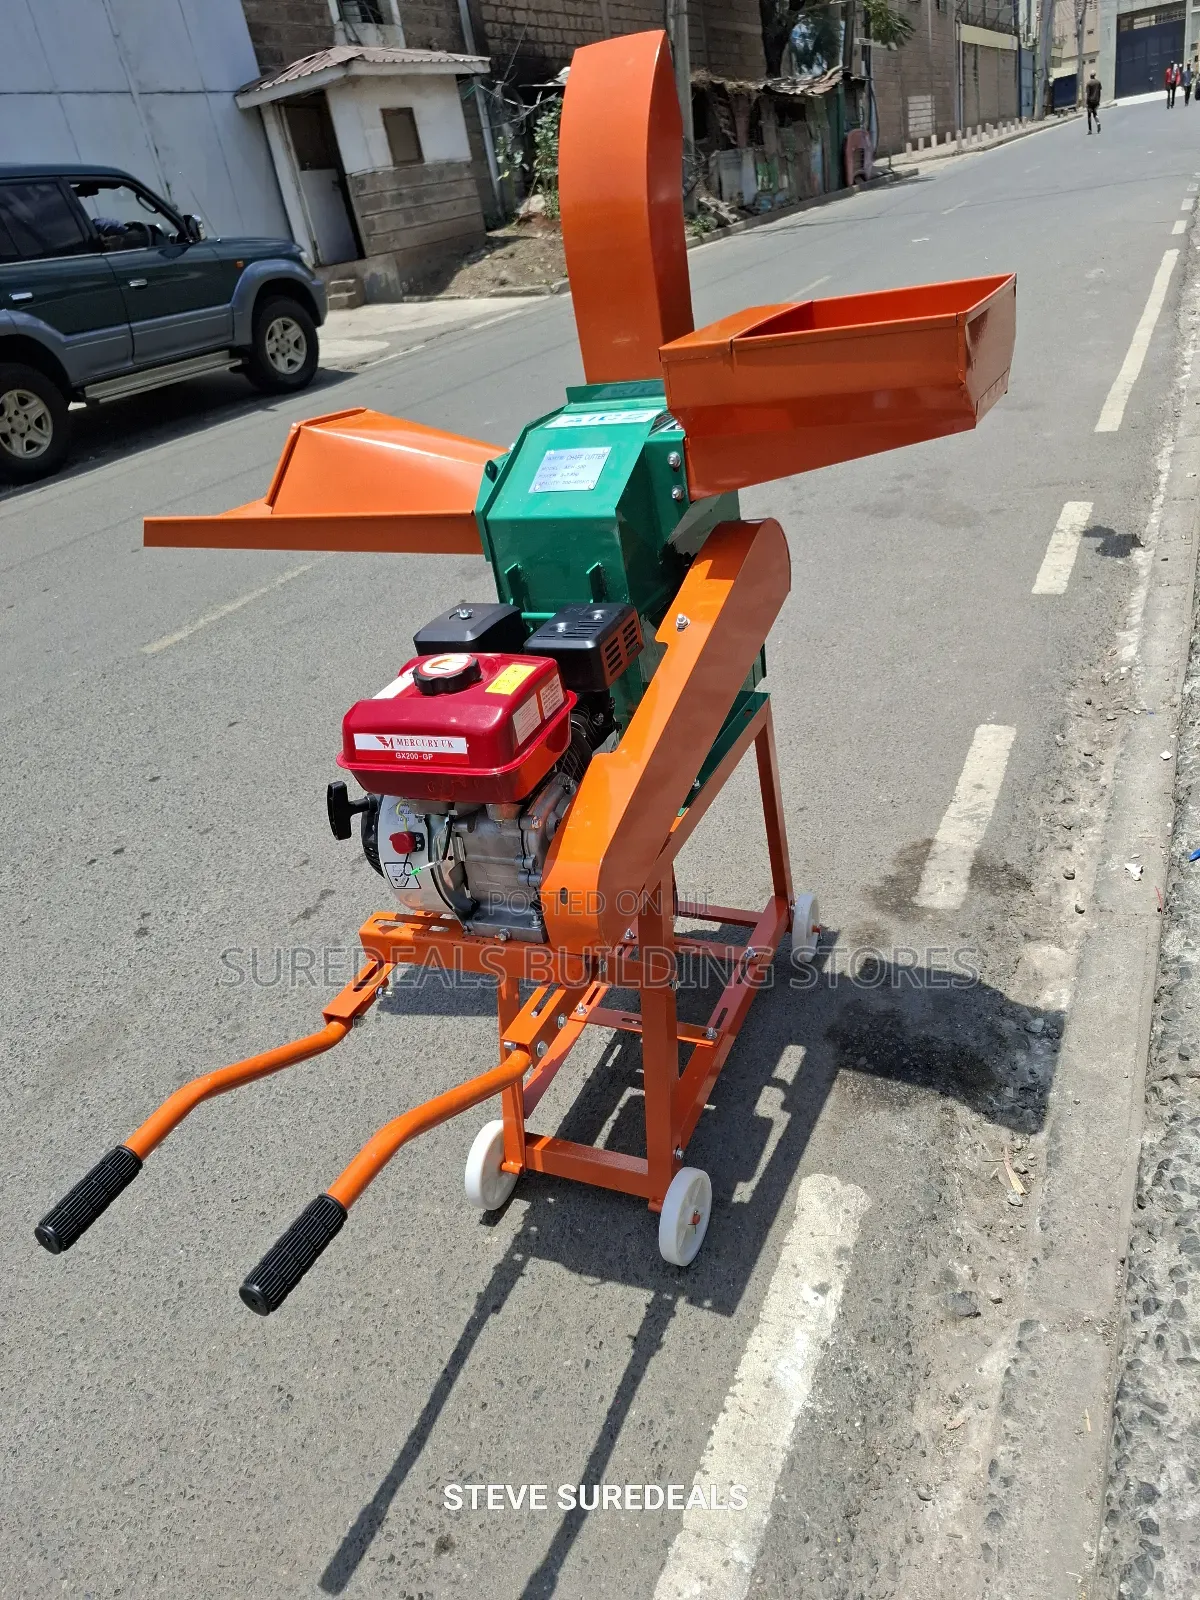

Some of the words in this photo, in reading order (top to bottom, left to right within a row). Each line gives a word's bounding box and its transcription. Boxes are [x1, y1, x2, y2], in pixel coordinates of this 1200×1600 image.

[396, 738, 439, 748] MERCURY
[440, 739, 454, 749] UK
[395, 751, 434, 761] GX200-GP
